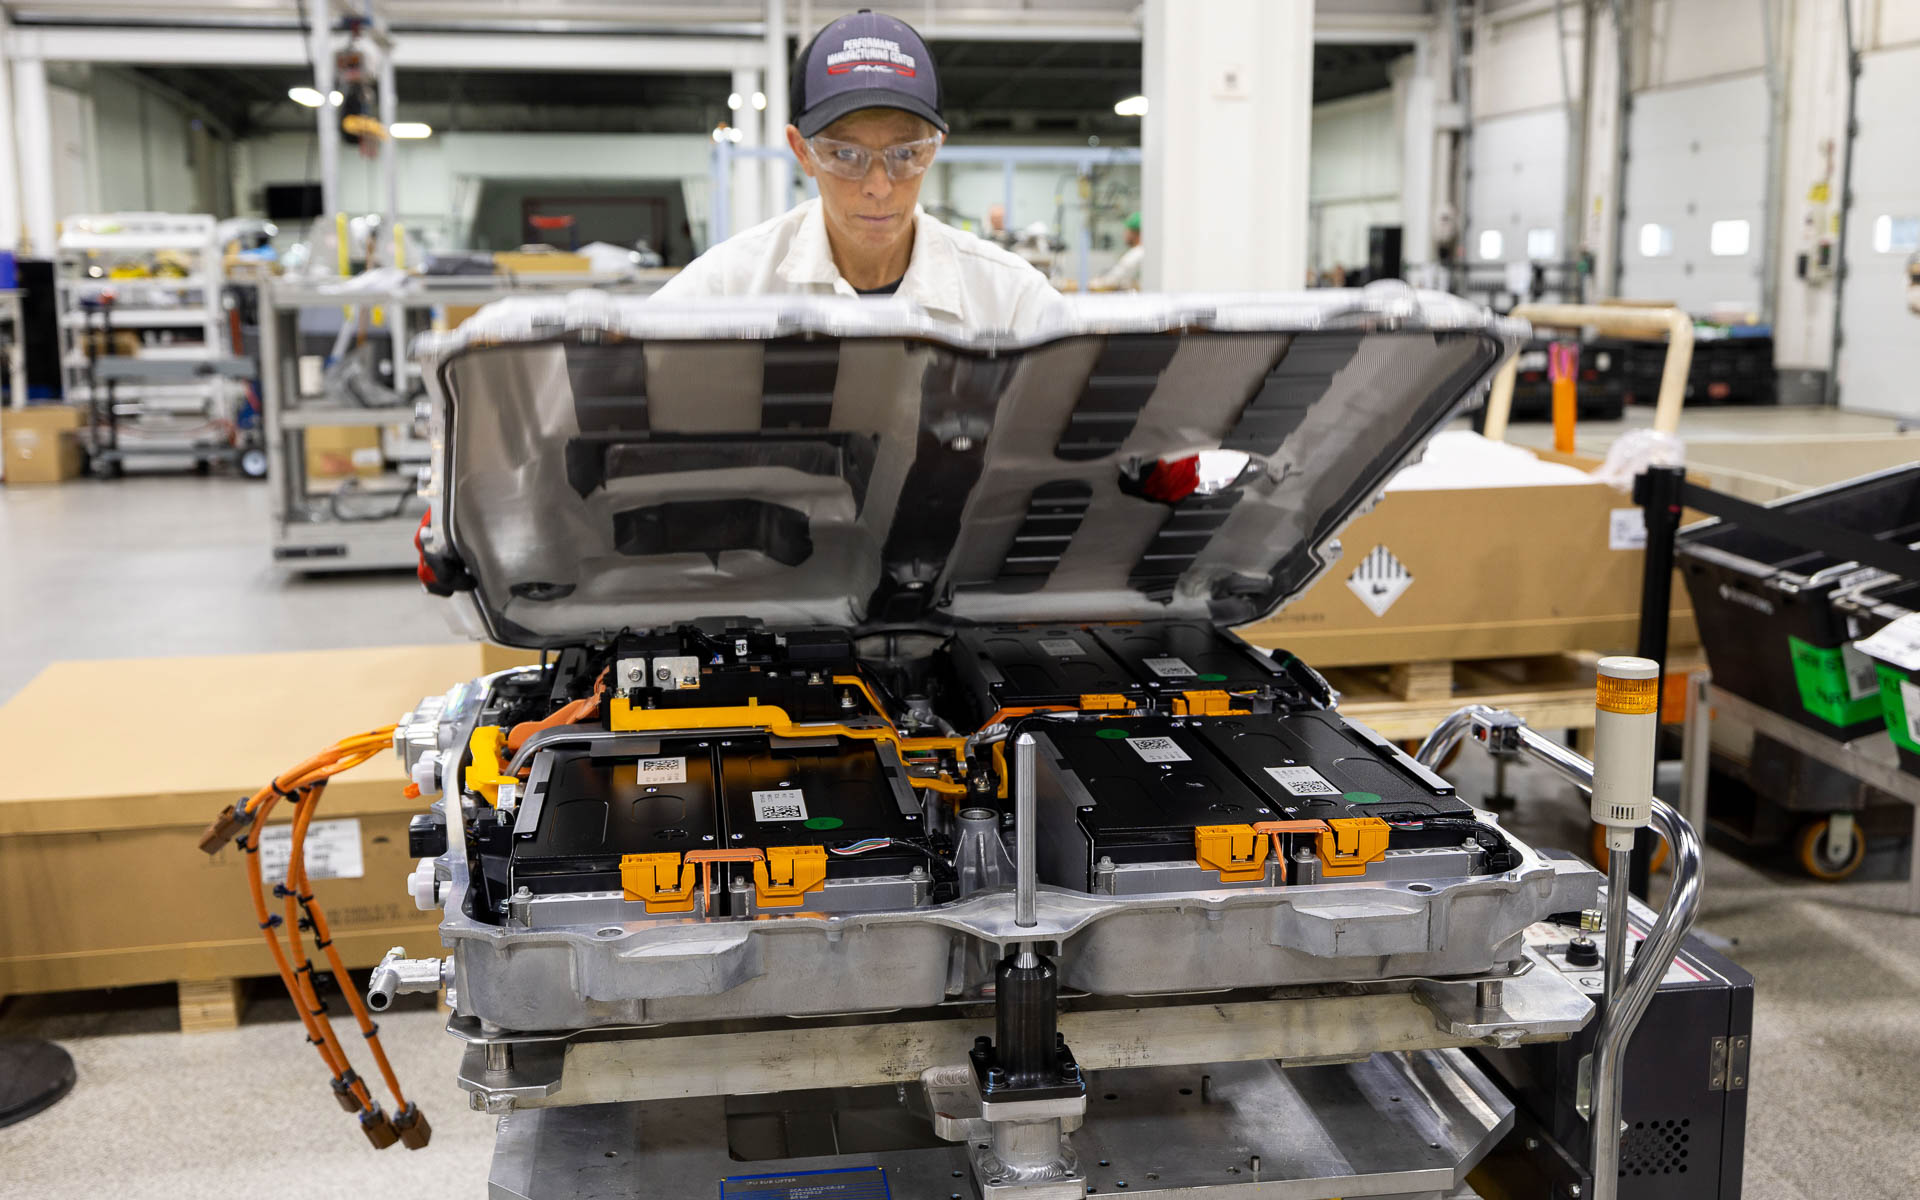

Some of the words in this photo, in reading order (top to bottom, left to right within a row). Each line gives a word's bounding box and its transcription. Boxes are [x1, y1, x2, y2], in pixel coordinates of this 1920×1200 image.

[843, 37, 900, 52] PERFORMANCE
[827, 48, 889, 66] MANUFACTURING
[889, 50, 916, 68] CENTER
